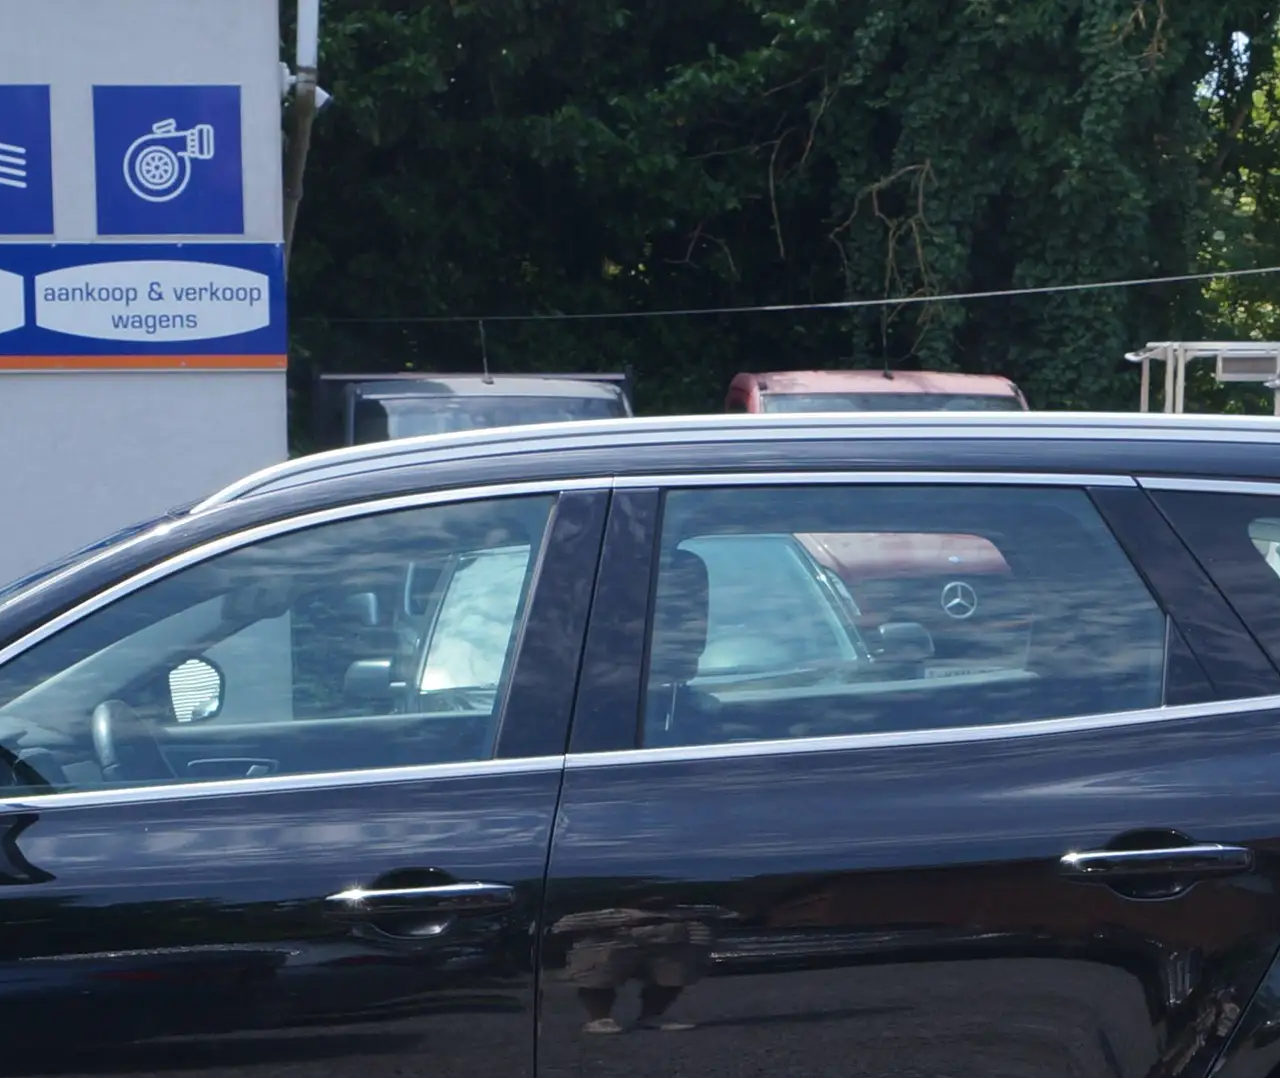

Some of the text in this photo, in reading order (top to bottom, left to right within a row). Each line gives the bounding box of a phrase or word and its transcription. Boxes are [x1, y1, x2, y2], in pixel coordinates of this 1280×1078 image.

[43, 281, 262, 307] aankoop & verkoop
[111, 314, 198, 335] wagens
